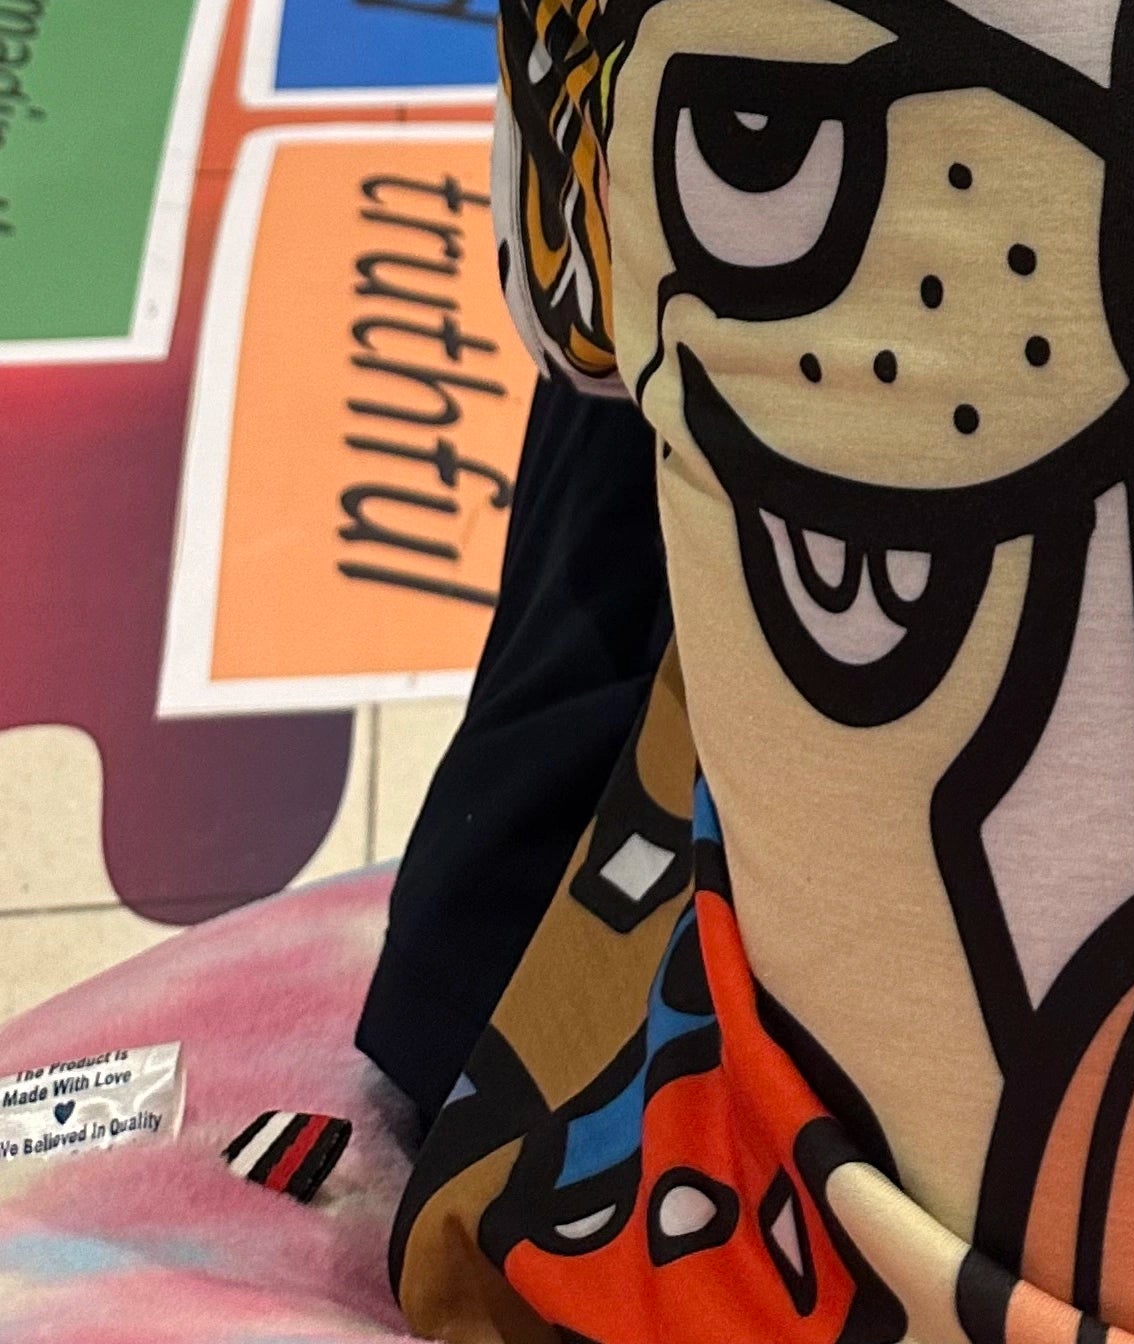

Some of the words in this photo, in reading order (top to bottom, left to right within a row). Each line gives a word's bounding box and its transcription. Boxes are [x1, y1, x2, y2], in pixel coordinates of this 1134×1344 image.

[337, 173, 513, 608] truthful
[49, 1051, 110, 1075] Product
[3, 1086, 48, 1108] Made
[53, 1074, 89, 1097] With
[95, 1070, 132, 1087] Love
[24, 1123, 87, 1154] Believed
[92, 1122, 106, 1139] In
[110, 1111, 162, 1136] Quality
